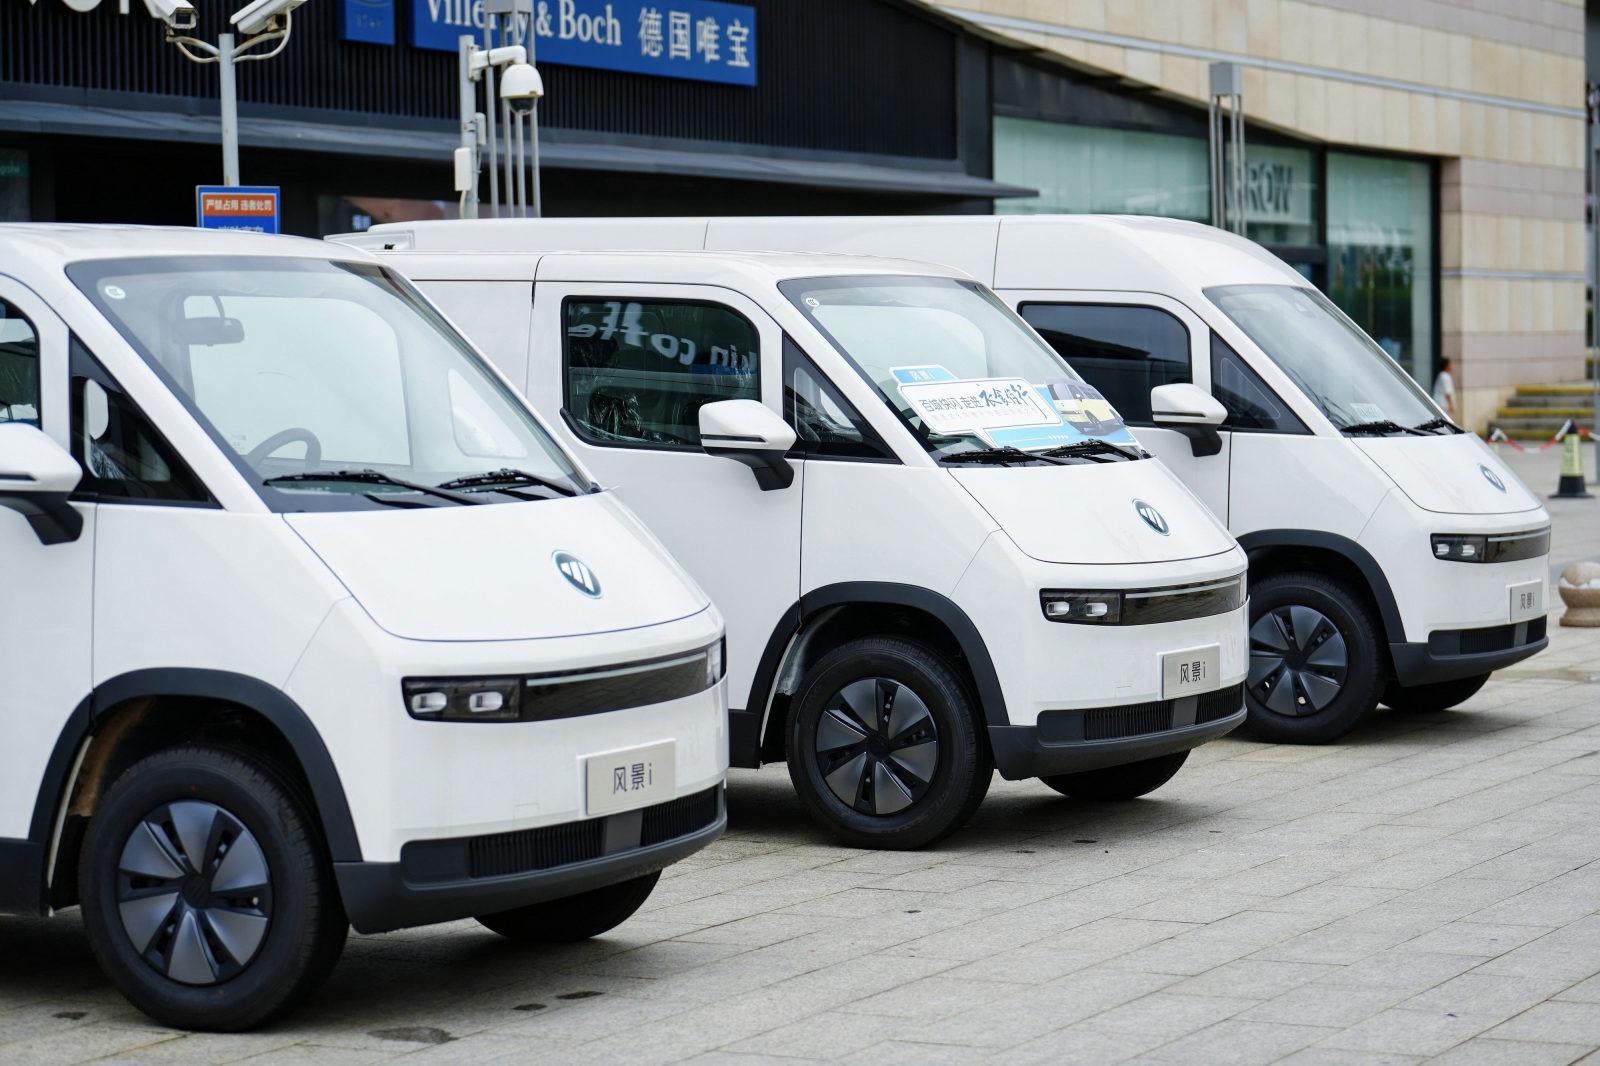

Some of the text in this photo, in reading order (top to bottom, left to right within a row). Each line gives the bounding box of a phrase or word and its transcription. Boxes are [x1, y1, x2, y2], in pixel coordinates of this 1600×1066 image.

[536, 1, 554, 38] &
[559, 2, 622, 46] Boch
[638, 7, 751, 68] 德国唯宝
[1180, 661, 1206, 685] 风景i
[612, 762, 653, 795] 风景i
